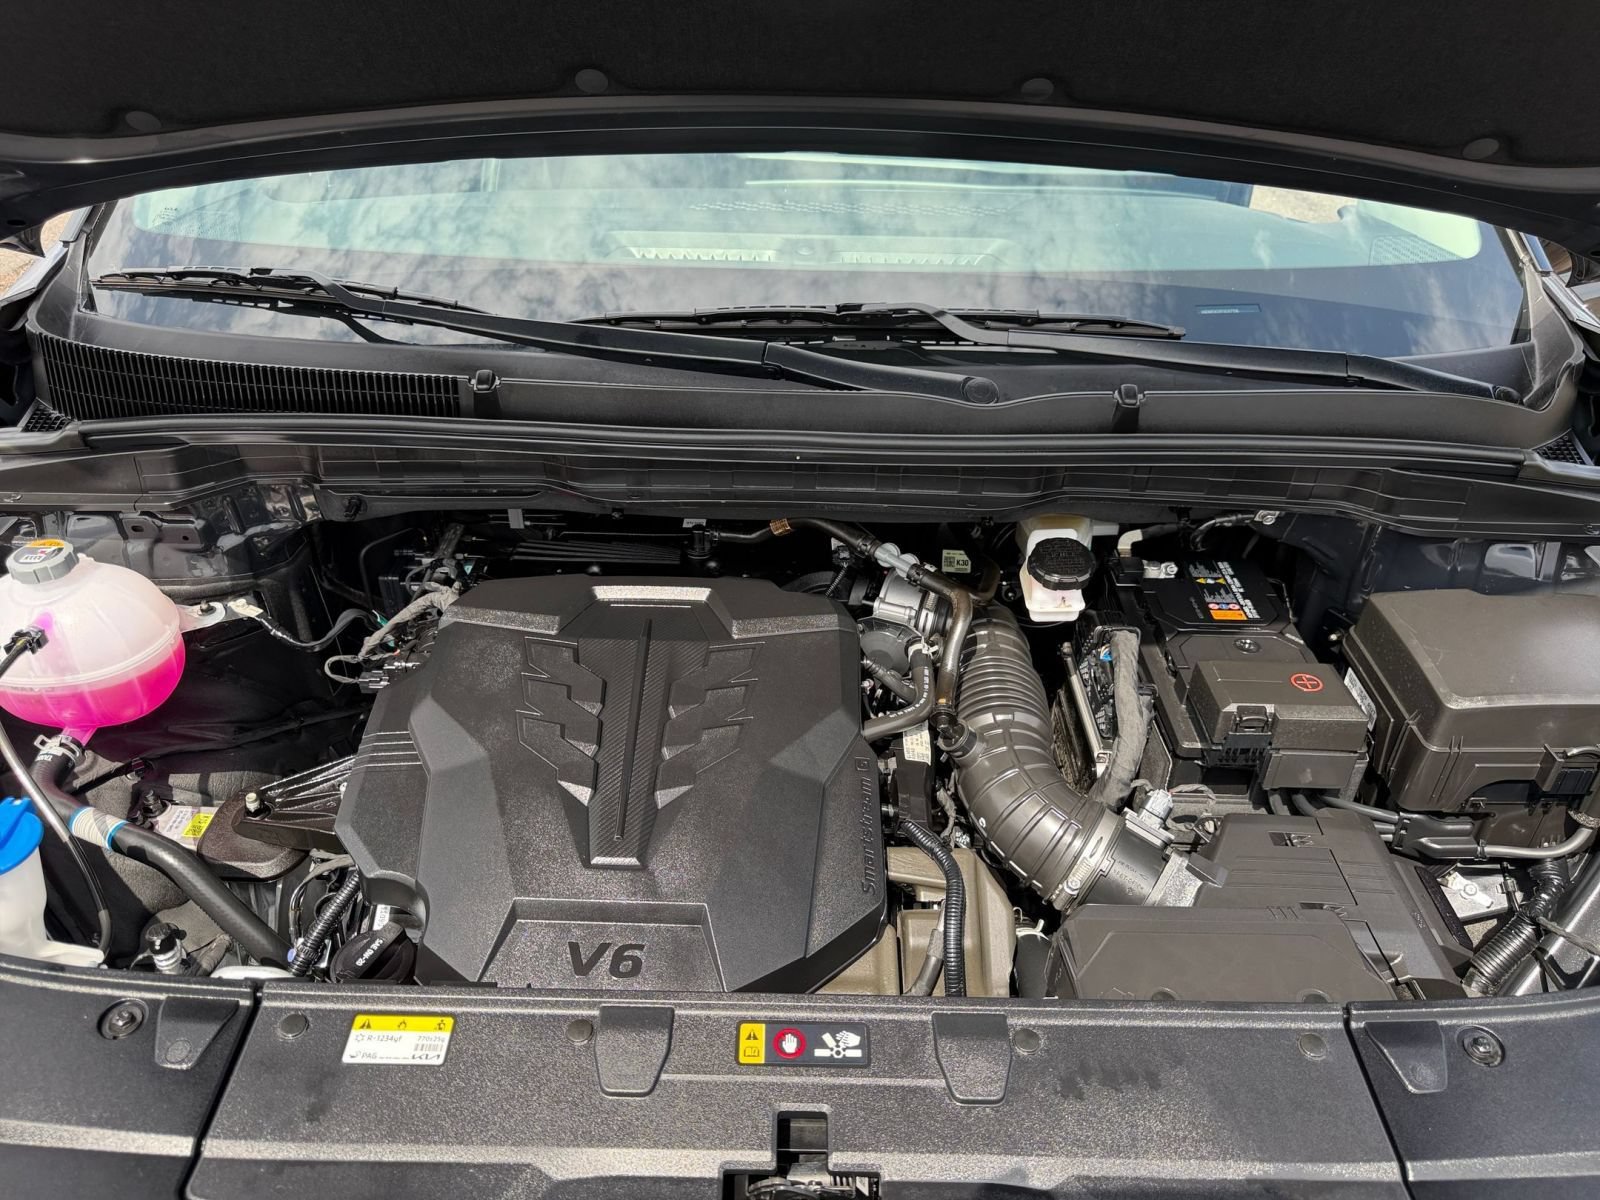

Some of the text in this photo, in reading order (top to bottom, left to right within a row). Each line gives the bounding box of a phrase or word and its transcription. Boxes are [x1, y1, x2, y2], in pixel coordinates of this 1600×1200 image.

[956, 559, 969, 567] K30
[860, 775, 877, 896] Smartstream
[370, 938, 384, 951] SAE
[567, 941, 646, 979] V6
[366, 1034, 403, 1043] R-1234yf
[360, 1051, 378, 1060] PAG
